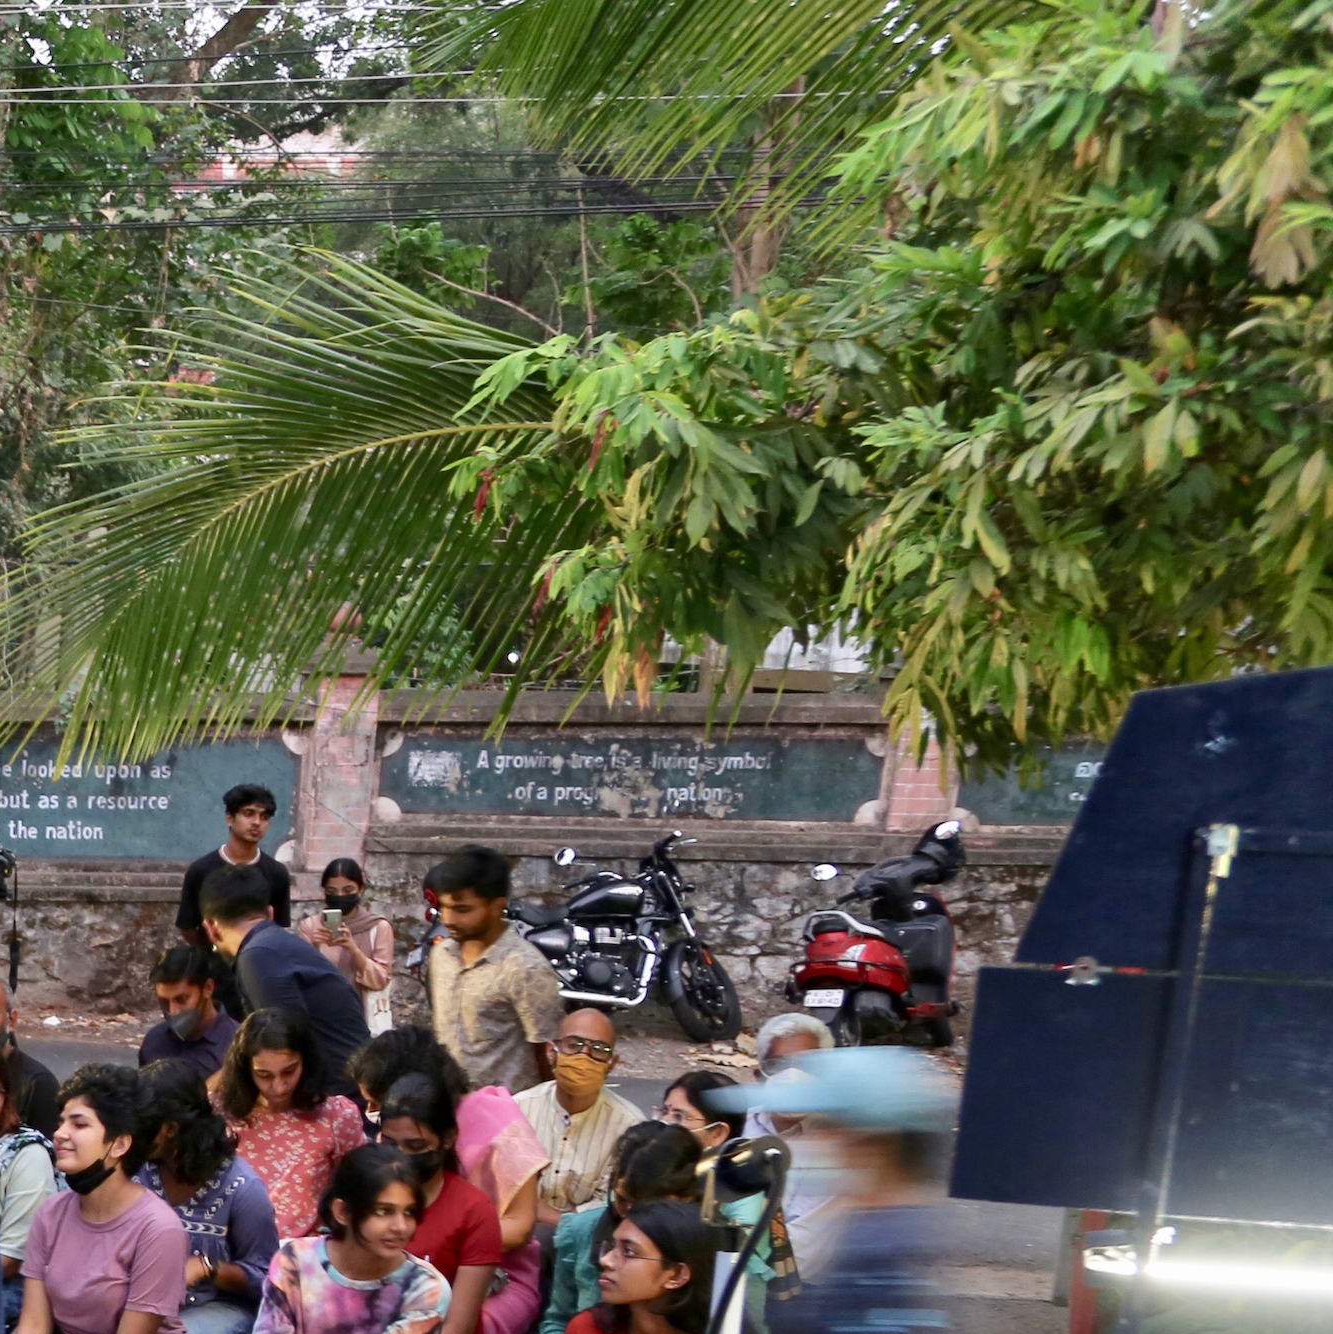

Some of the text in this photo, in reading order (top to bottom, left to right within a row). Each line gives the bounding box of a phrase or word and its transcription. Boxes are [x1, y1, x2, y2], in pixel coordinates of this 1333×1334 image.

[22, 759, 83, 778] looked
[94, 764, 141, 784] upon
[150, 765, 172, 778] as
[476, 750, 489, 769] A
[651, 752, 699, 776] living
[705, 752, 771, 775] symbol
[515, 782, 534, 800] of
[536, 785, 548, 800] a
[666, 782, 722, 801] naton
[38, 795, 59, 809] as
[66, 795, 77, 809] a
[8, 820, 38, 839] the
[45, 821, 104, 840] nation
